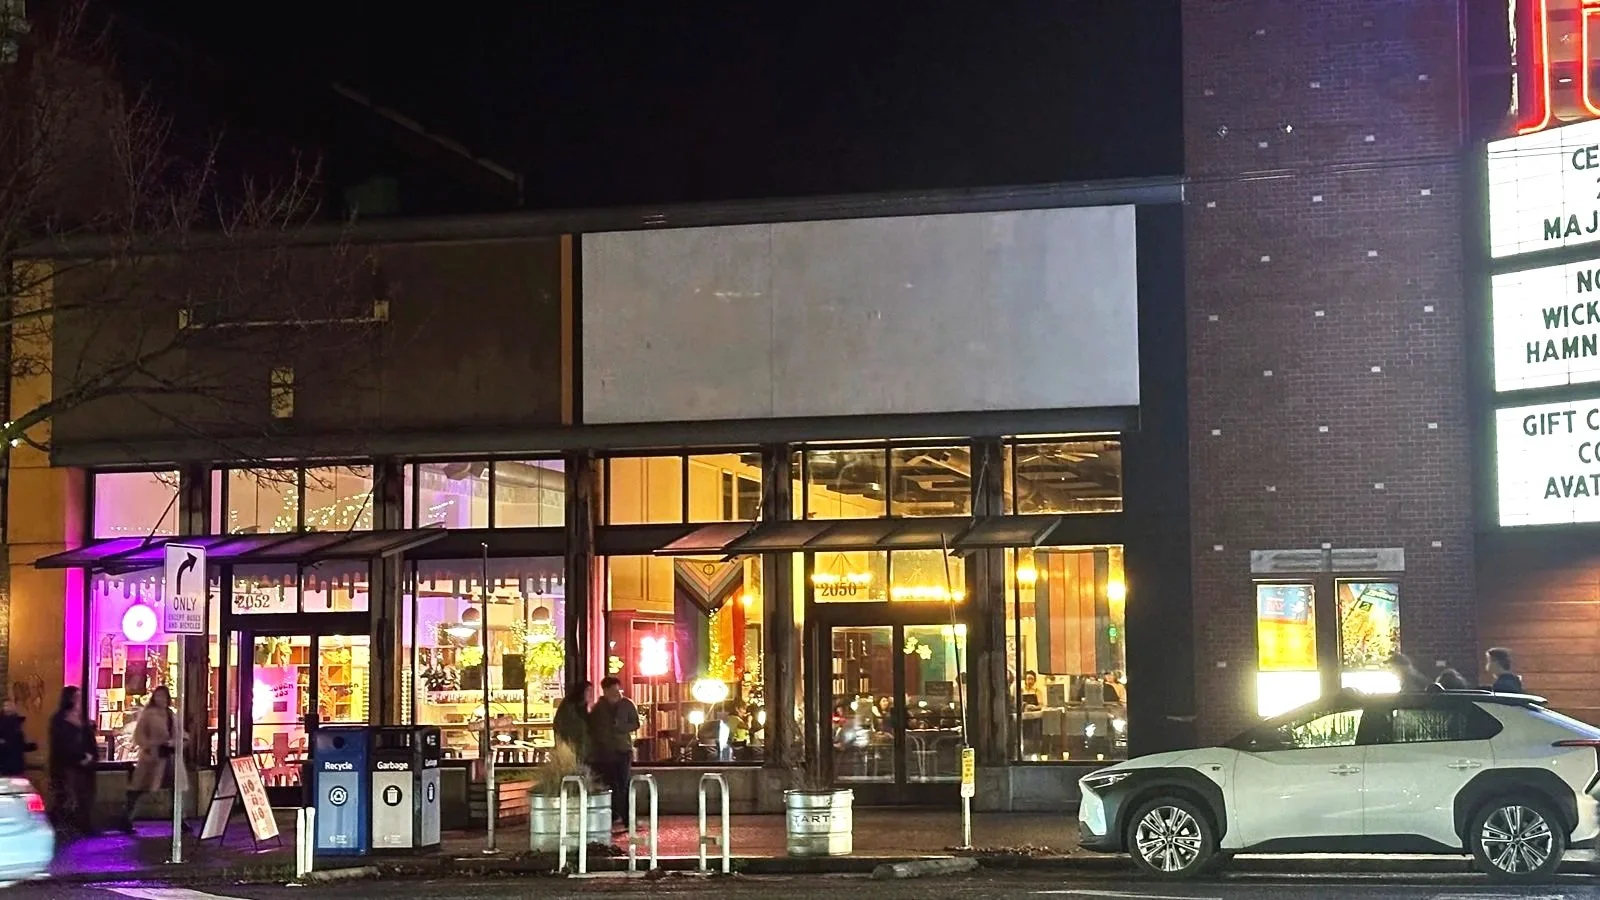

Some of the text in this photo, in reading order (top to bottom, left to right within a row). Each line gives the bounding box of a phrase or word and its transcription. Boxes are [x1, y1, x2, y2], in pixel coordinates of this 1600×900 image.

[1572, 144, 1599, 170] CE
[1543, 209, 1598, 241] MAJ
[1542, 300, 1600, 329] WICK
[1526, 333, 1598, 364] HAMN
[1523, 410, 1577, 436] GIFT
[1543, 473, 1600, 499] AVAT
[238, 594, 270, 609] 2052
[821, 581, 857, 597] 2050
[173, 596, 197, 611] ONLY
[324, 761, 353, 770] Recycle
[376, 761, 409, 770] Garbage
